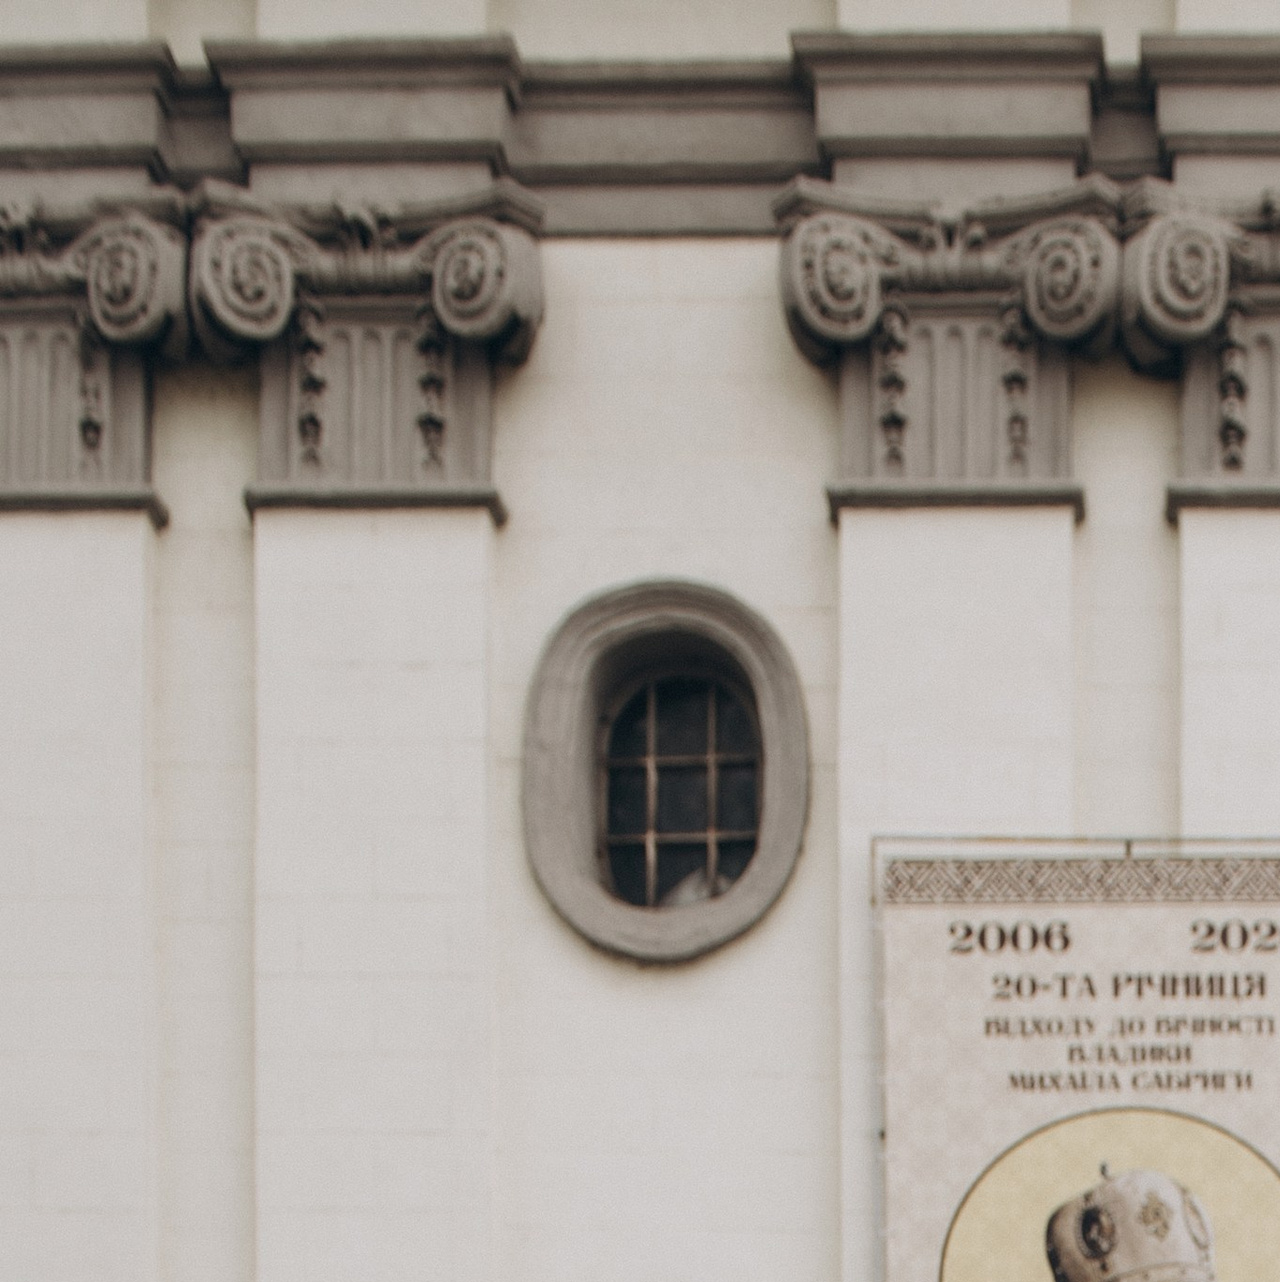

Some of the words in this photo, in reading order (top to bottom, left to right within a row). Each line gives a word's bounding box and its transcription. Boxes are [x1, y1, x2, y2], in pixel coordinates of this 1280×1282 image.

[948, 920, 1073, 955] 2006
[992, 972, 1098, 1000] 20-ТА
[1111, 971, 1268, 1004] РІЧНИЦЯ
[1108, 1015, 1147, 1039] ДО
